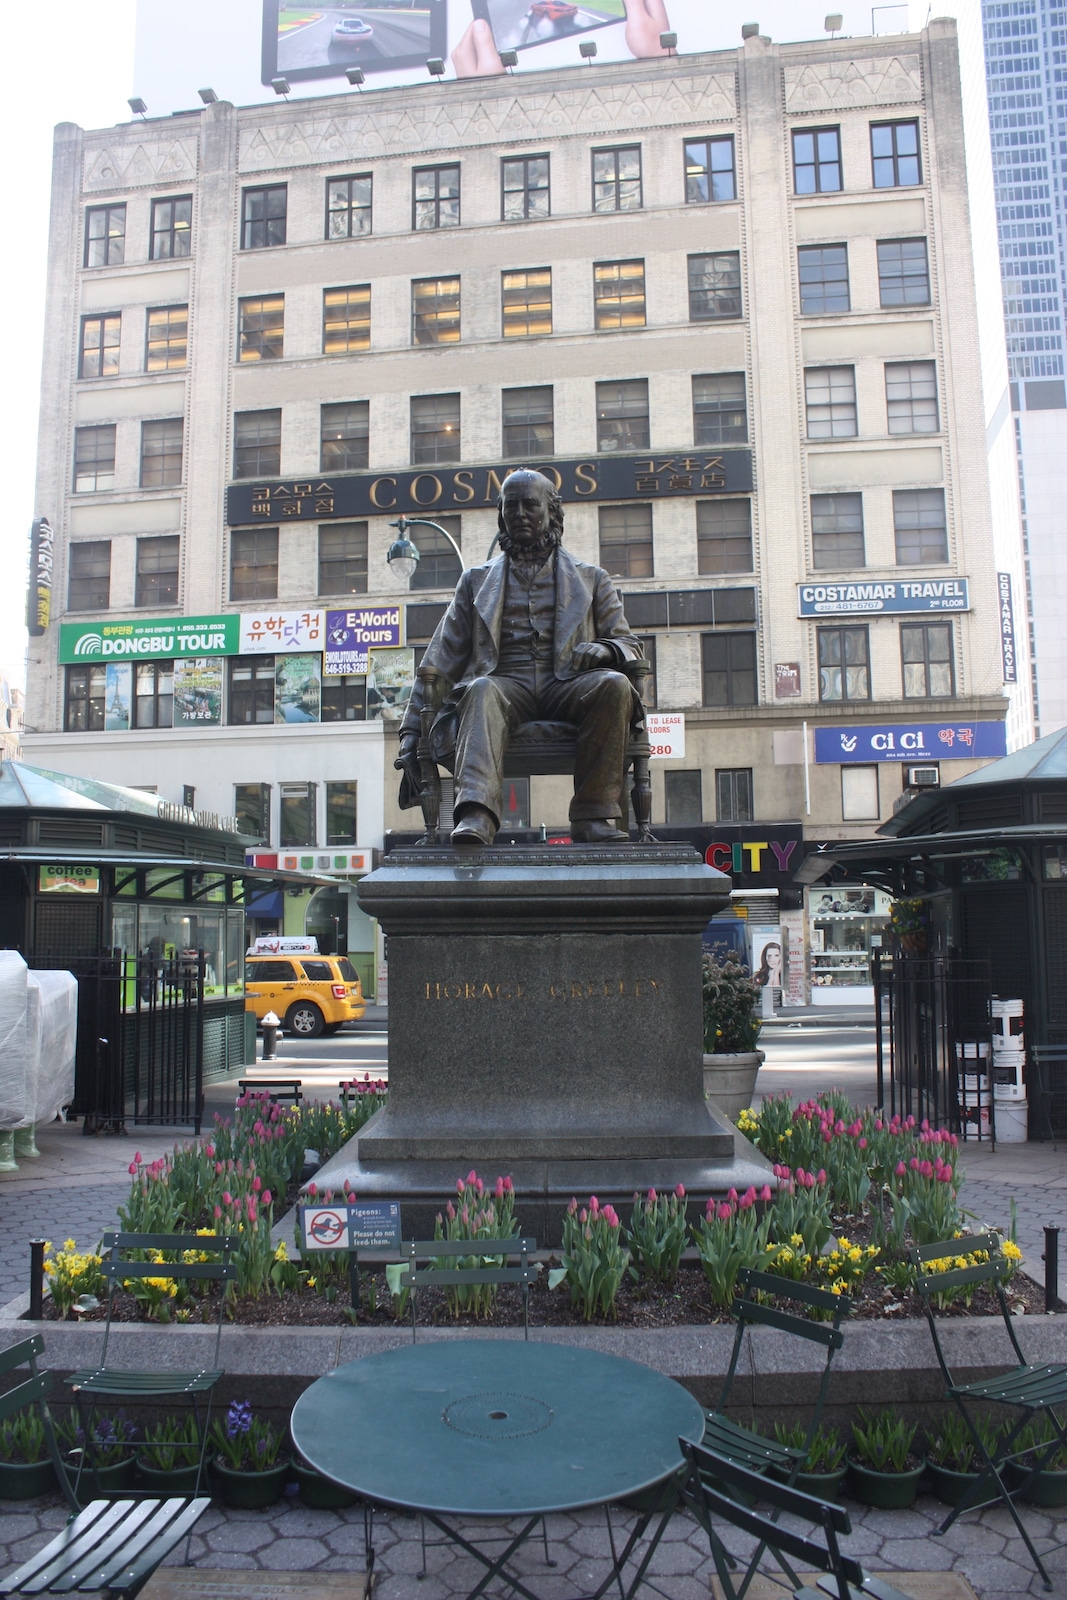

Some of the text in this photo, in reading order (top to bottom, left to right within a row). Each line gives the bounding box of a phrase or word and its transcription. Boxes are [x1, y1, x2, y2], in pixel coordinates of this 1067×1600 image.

[634, 456, 725, 474] コスモス
[252, 482, 334, 501] 코스모스
[802, 582, 964, 602] COSTAMAR TRAVEL
[835, 602, 880, 610] 481-6767
[941, 600, 964, 608] FLOOR
[1000, 574, 1012, 634] COSTAMAR
[346, 610, 400, 628] E-World
[102, 625, 133, 636] 동부관광
[354, 628, 393, 643] Tours
[102, 633, 226, 655] DONGBU TOUR
[1004, 637, 1015, 681] TRAVEL
[325, 662, 368, 675] 646-519-3288
[650, 716, 682, 725] TO LEASE
[646, 726, 671, 734] FLOORS
[870, 728, 974, 750] Ci Ci 약국
[650, 745, 672, 755] 280
[158, 800, 191, 825] GREELEY
[193, 809, 222, 831] SQUARE
[705, 840, 797, 873] CITY
[47, 865, 92, 876] coffee
[424, 978, 665, 1000] HORACE GREELEY
[350, 1208, 381, 1217] Pigeons:
